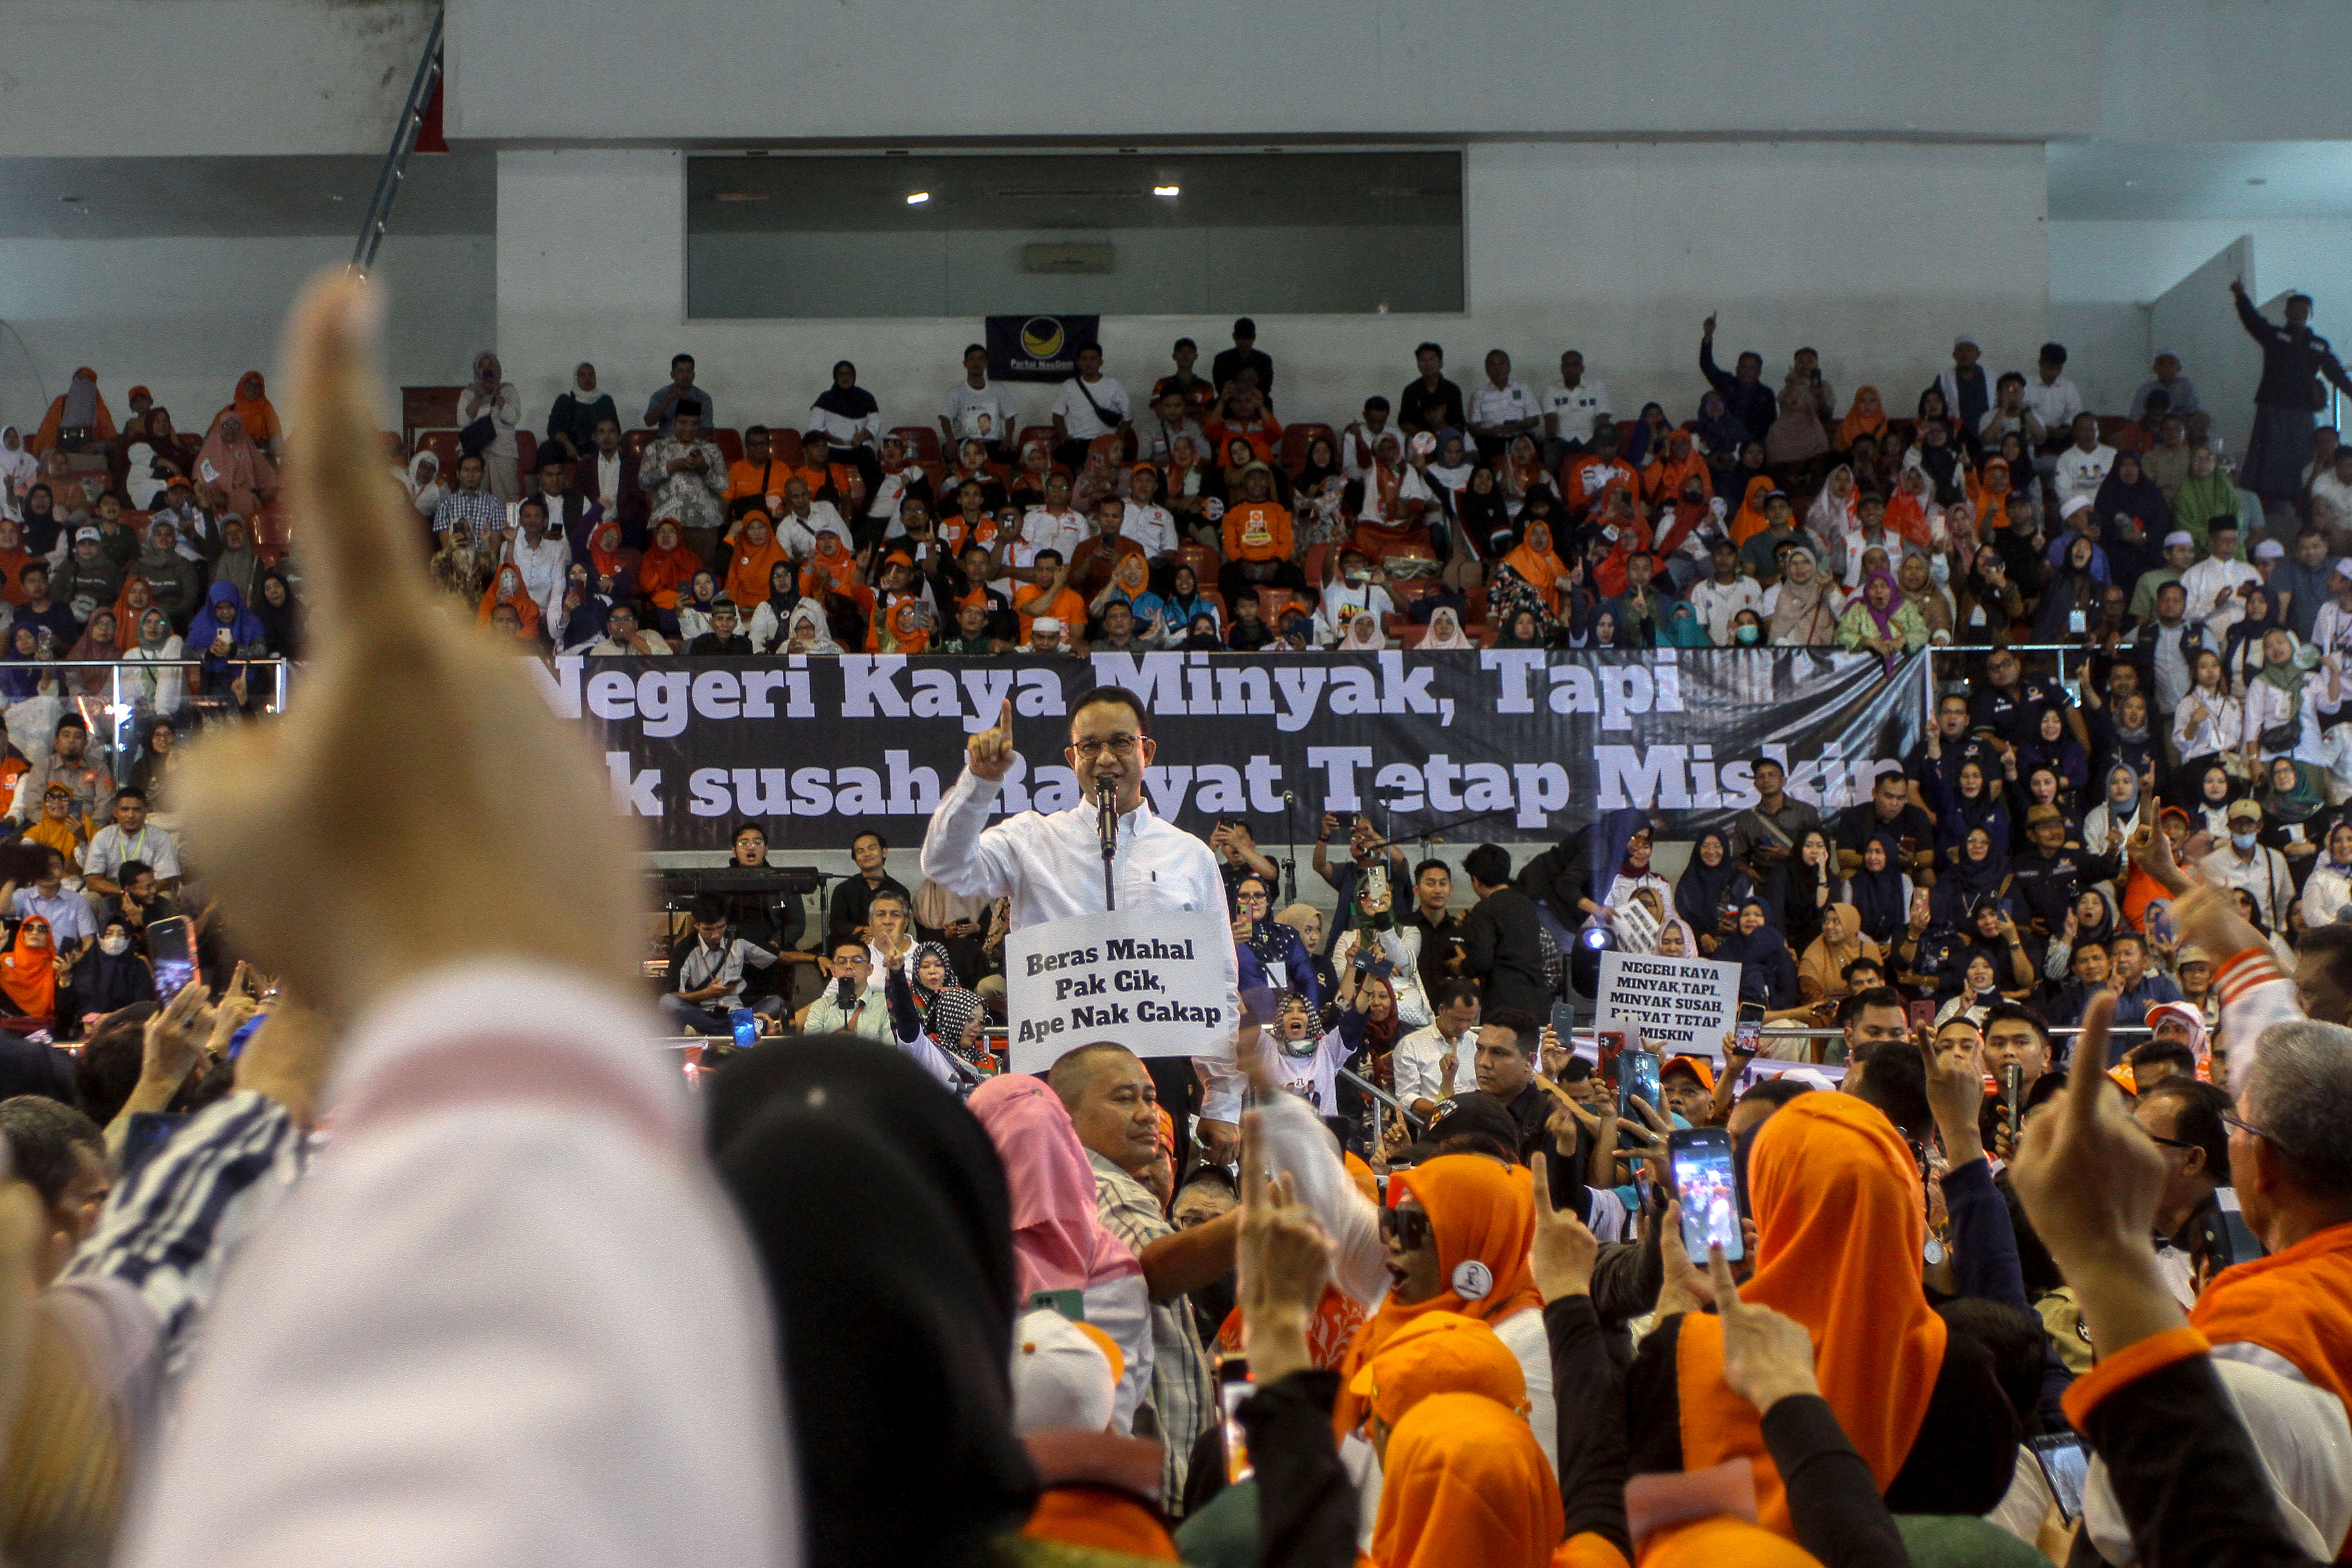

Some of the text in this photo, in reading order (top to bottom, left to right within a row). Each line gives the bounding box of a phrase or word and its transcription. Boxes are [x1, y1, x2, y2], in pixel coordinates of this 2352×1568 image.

[842, 653, 1067, 733] Kaya
[1091, 650, 1455, 733] Minyak,
[1480, 647, 1685, 731] Tapi
[690, 750, 941, 816] susah
[1308, 746, 1569, 828] Tetap
[1026, 938, 1195, 977] Beras Mahal
[1621, 961, 1719, 980] NEGERI KAYA
[1055, 969, 1166, 1001] Pak Cik,
[1610, 992, 1724, 1013] MINYAK SUSAH,
[1017, 1000, 1222, 1043] Ape Nak Cakap
[1639, 1027, 1694, 1042] MISKIN
[1675, 1014, 1722, 1028] TETAP
